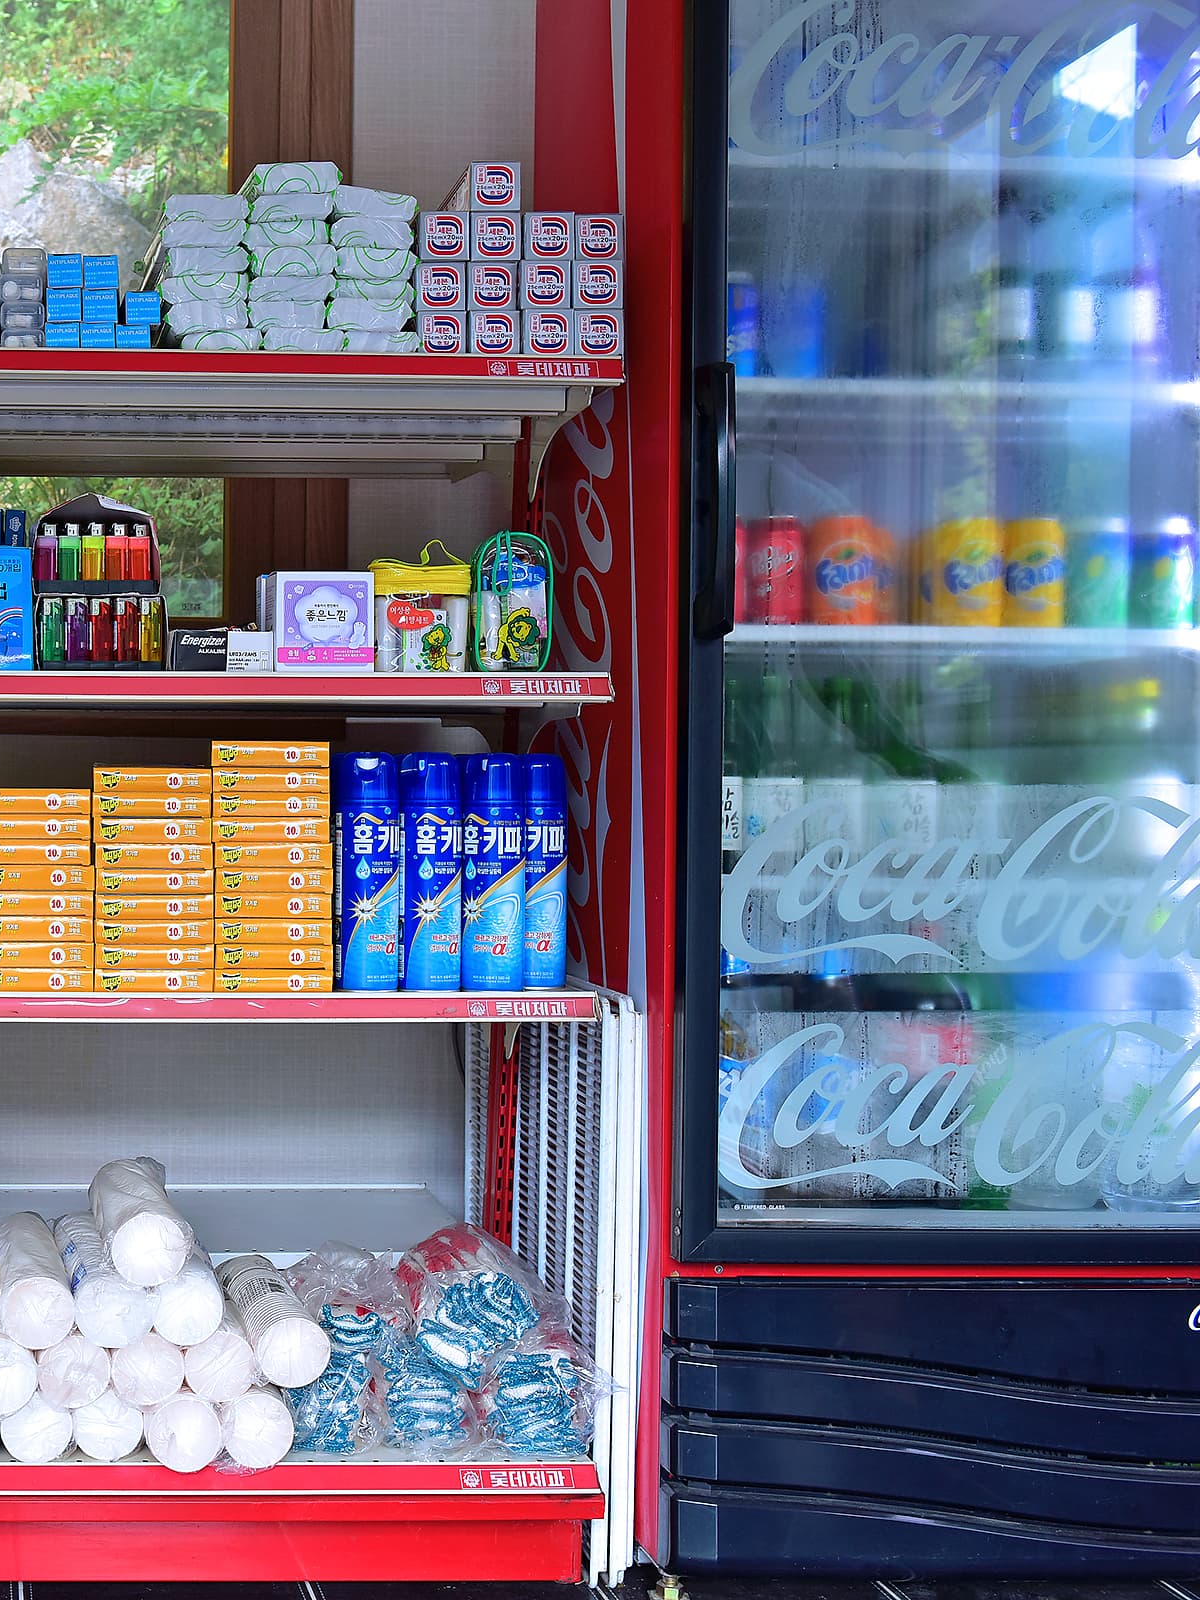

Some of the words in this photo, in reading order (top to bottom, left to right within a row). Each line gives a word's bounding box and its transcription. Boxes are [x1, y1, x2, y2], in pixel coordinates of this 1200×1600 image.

[516, 362, 590, 376] 롯데제과
[305, 609, 346, 622] 좋은느낌
[180, 634, 226, 648] Energizer
[510, 680, 581, 694] 롯데제과
[496, 1002, 567, 1015] 롯데제과
[490, 1469, 566, 1488] 롯데제과
